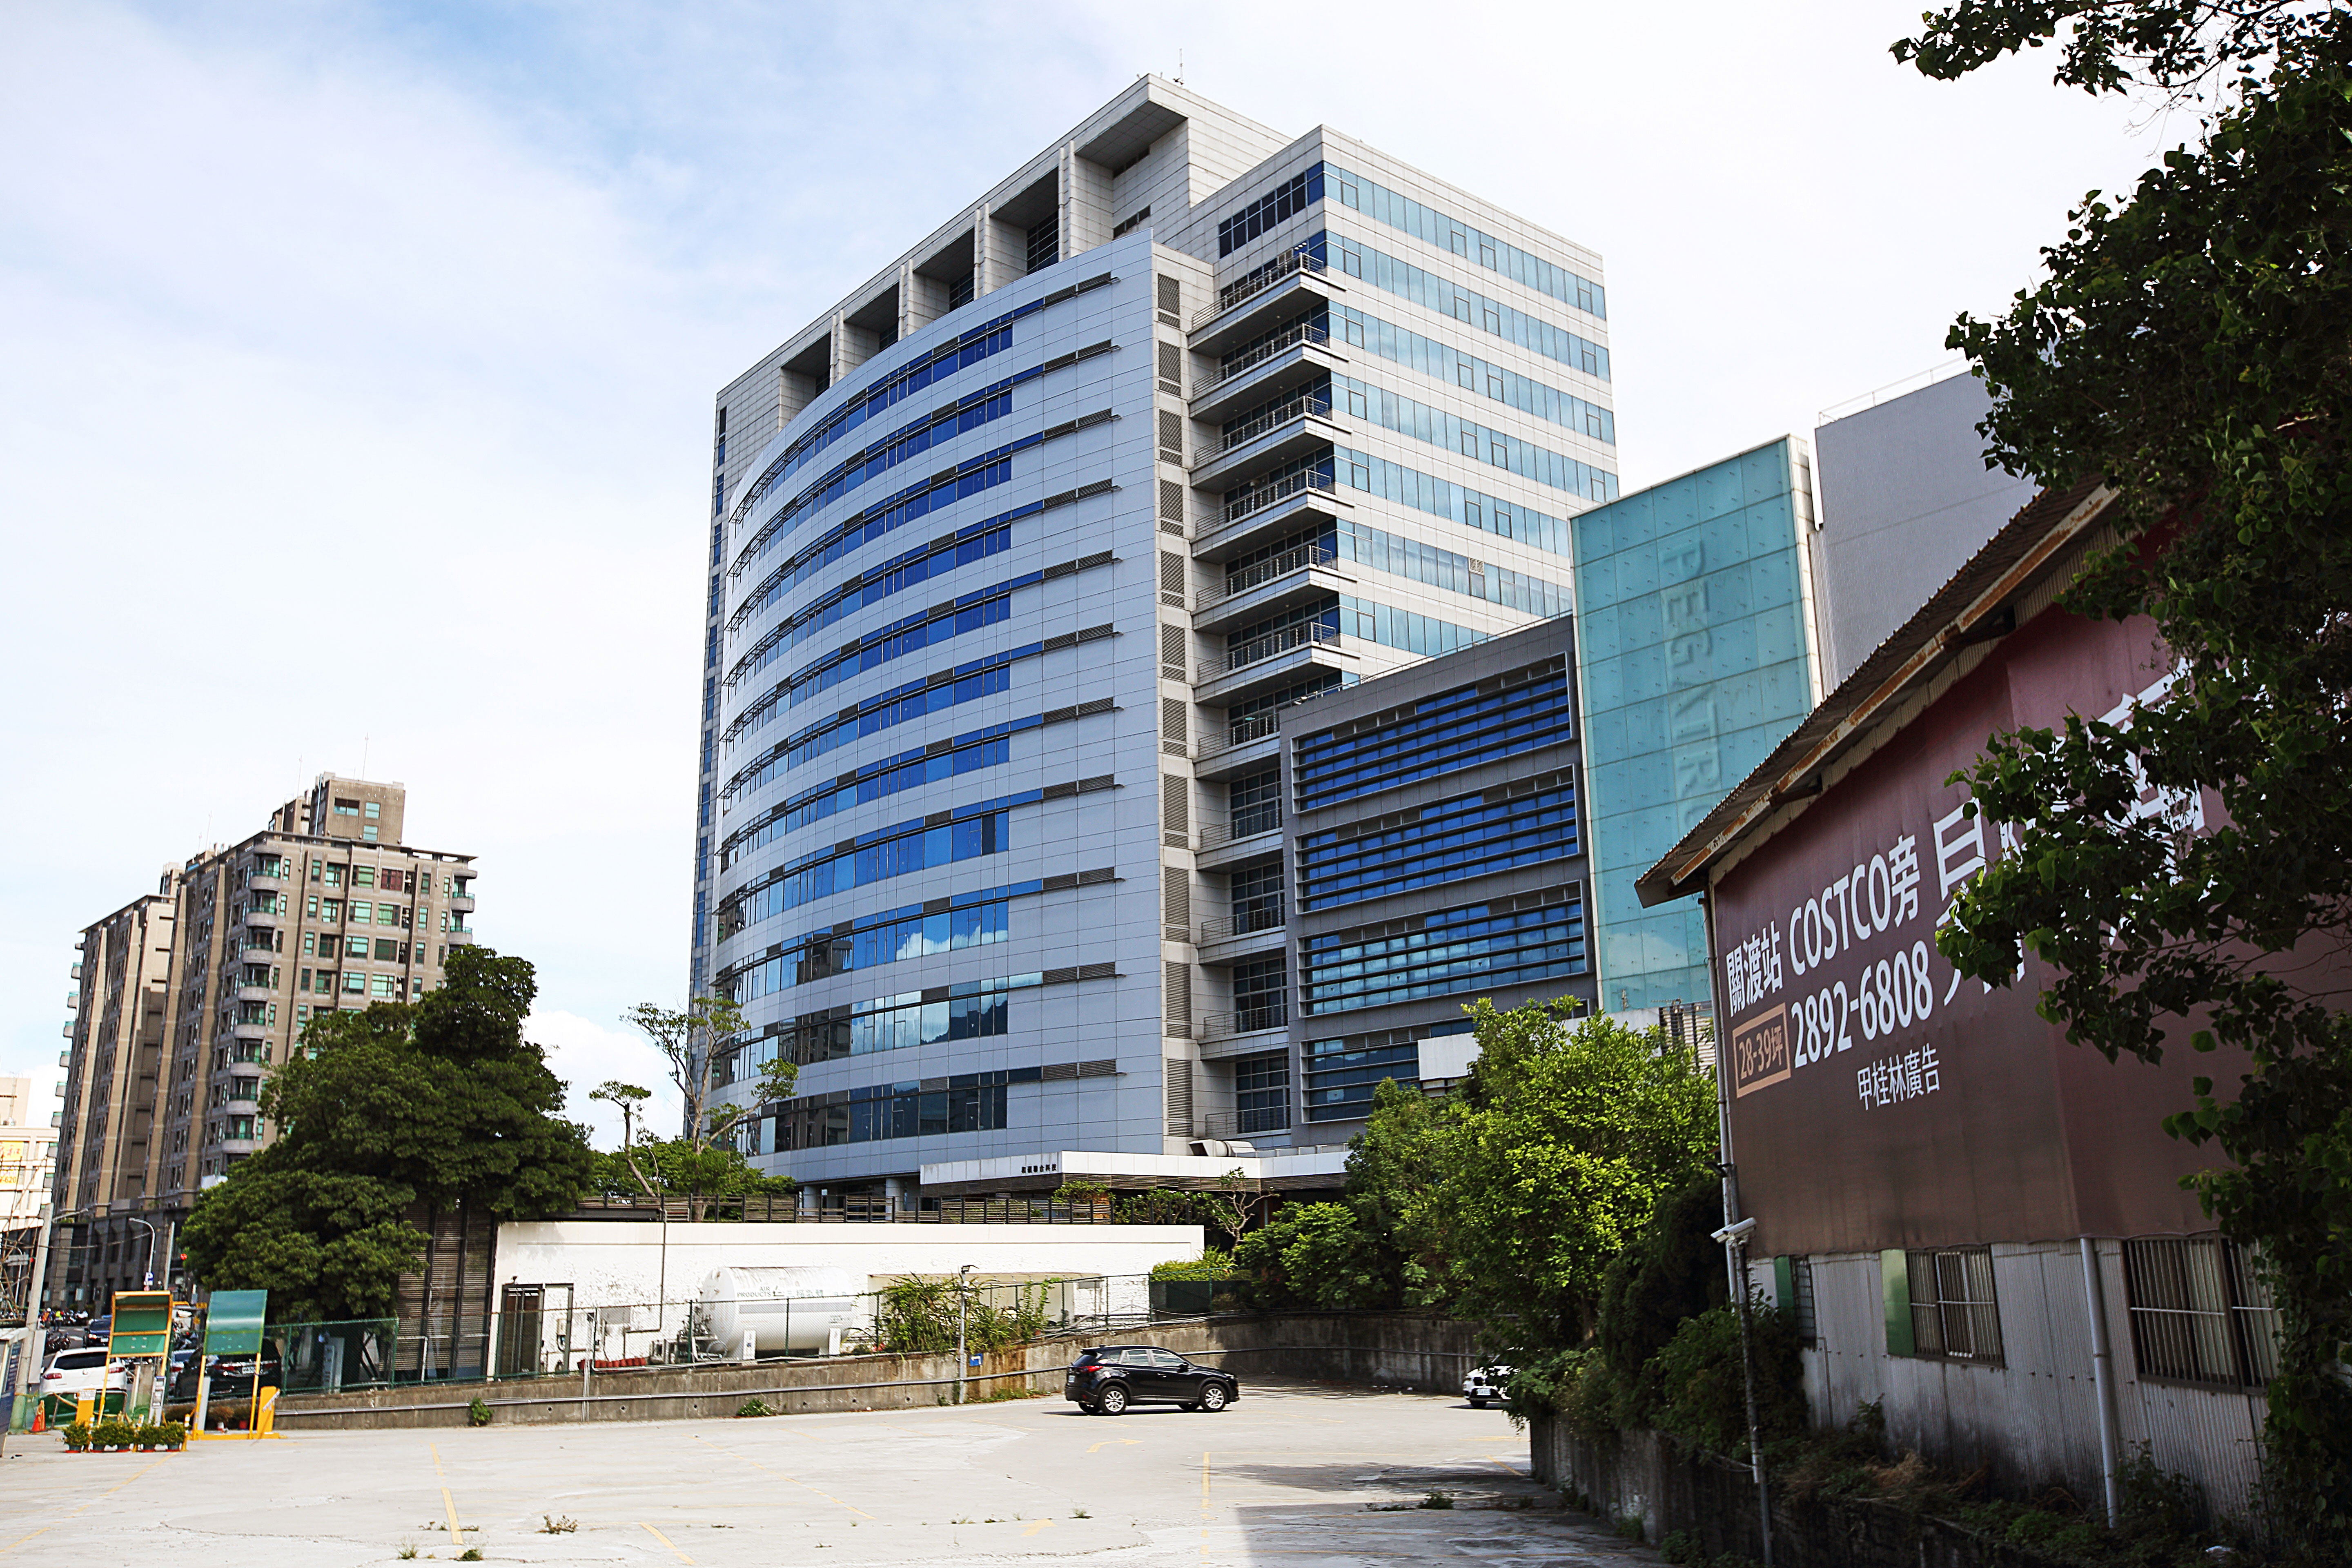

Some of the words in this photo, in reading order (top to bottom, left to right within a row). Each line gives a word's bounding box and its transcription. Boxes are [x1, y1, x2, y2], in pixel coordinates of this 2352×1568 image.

[1726, 920, 1783, 1017] 關渡站
[1791, 940, 1933, 1068] 2892-6808
[1739, 1025, 1783, 1080] 28-39坪
[1857, 1042, 1940, 1111] 甲桂林廣告
[145, 1272, 153, 1281] P
